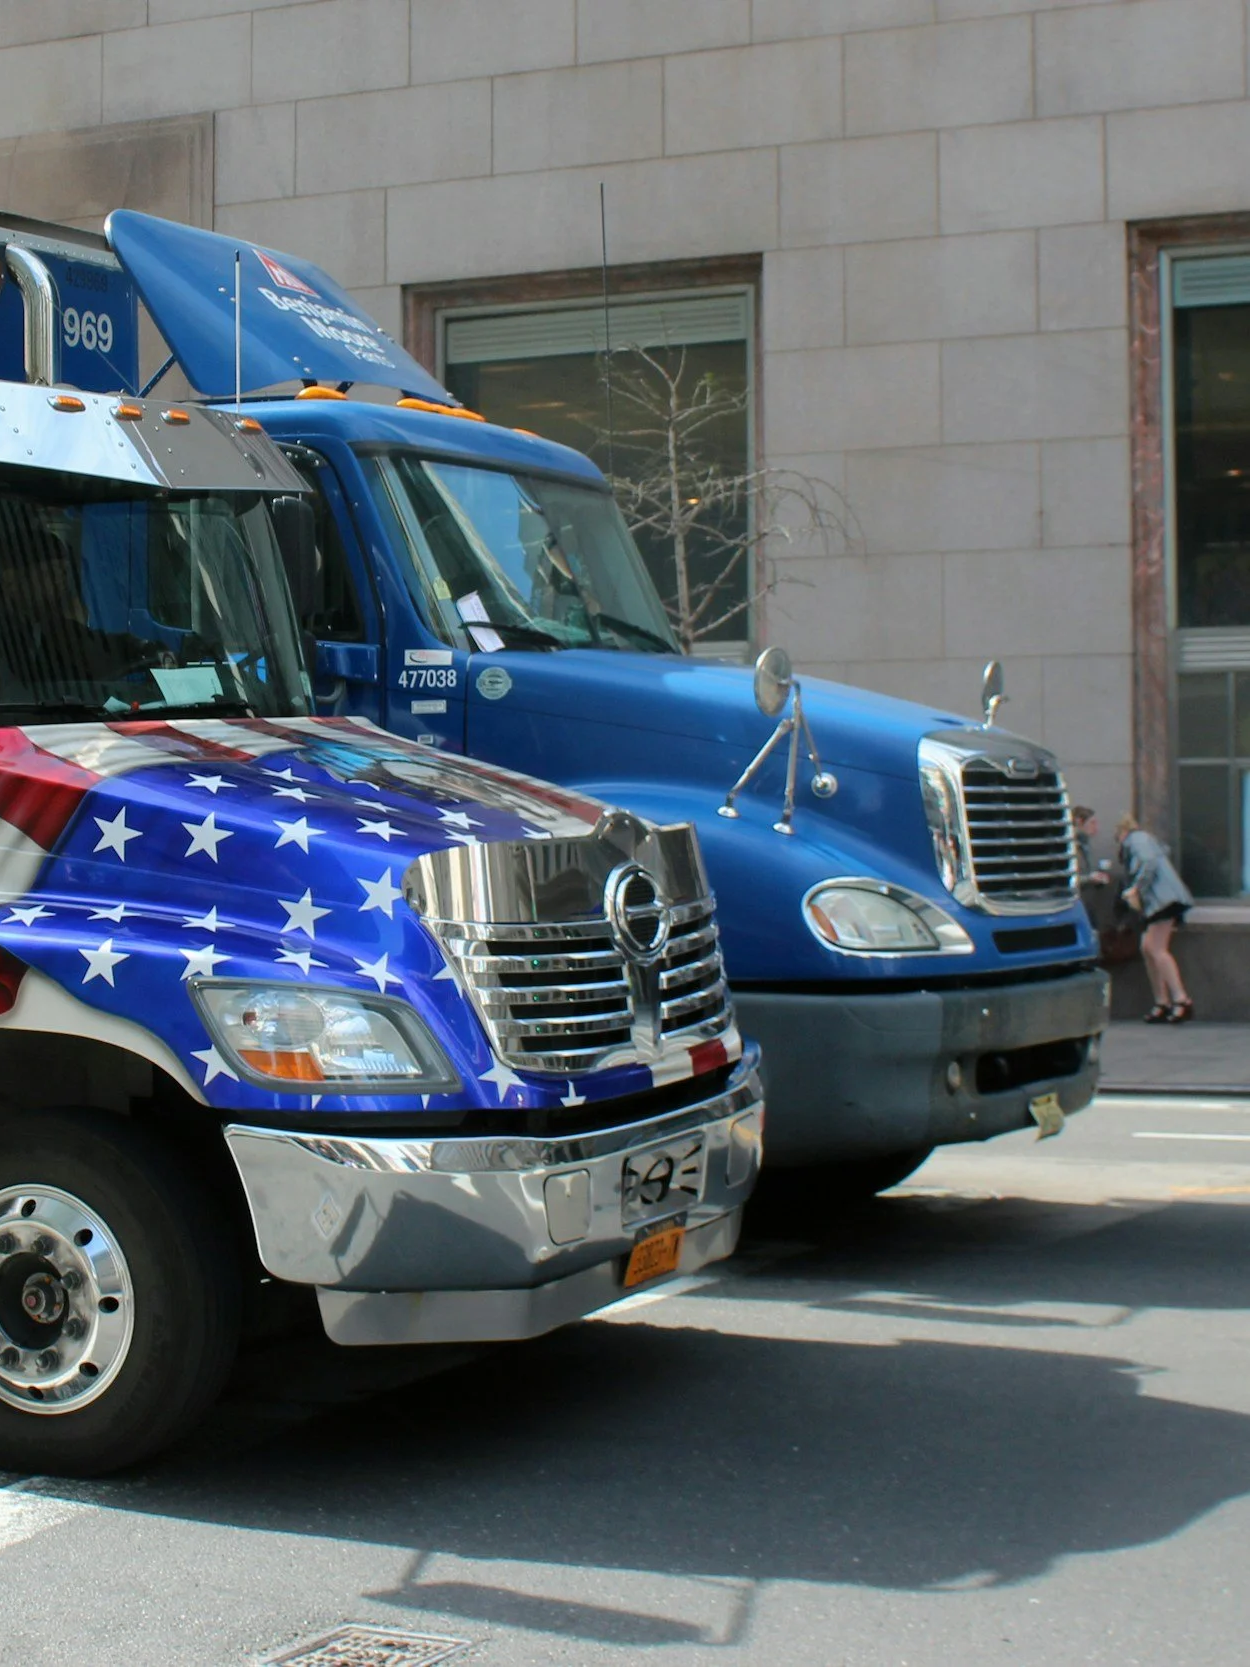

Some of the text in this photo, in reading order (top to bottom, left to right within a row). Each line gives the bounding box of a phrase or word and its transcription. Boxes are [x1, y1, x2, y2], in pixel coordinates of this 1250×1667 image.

[63, 307, 113, 353] 969
[257, 286, 375, 335] Benjamin
[300, 315, 386, 354] Moore
[398, 669, 458, 689] 477038
